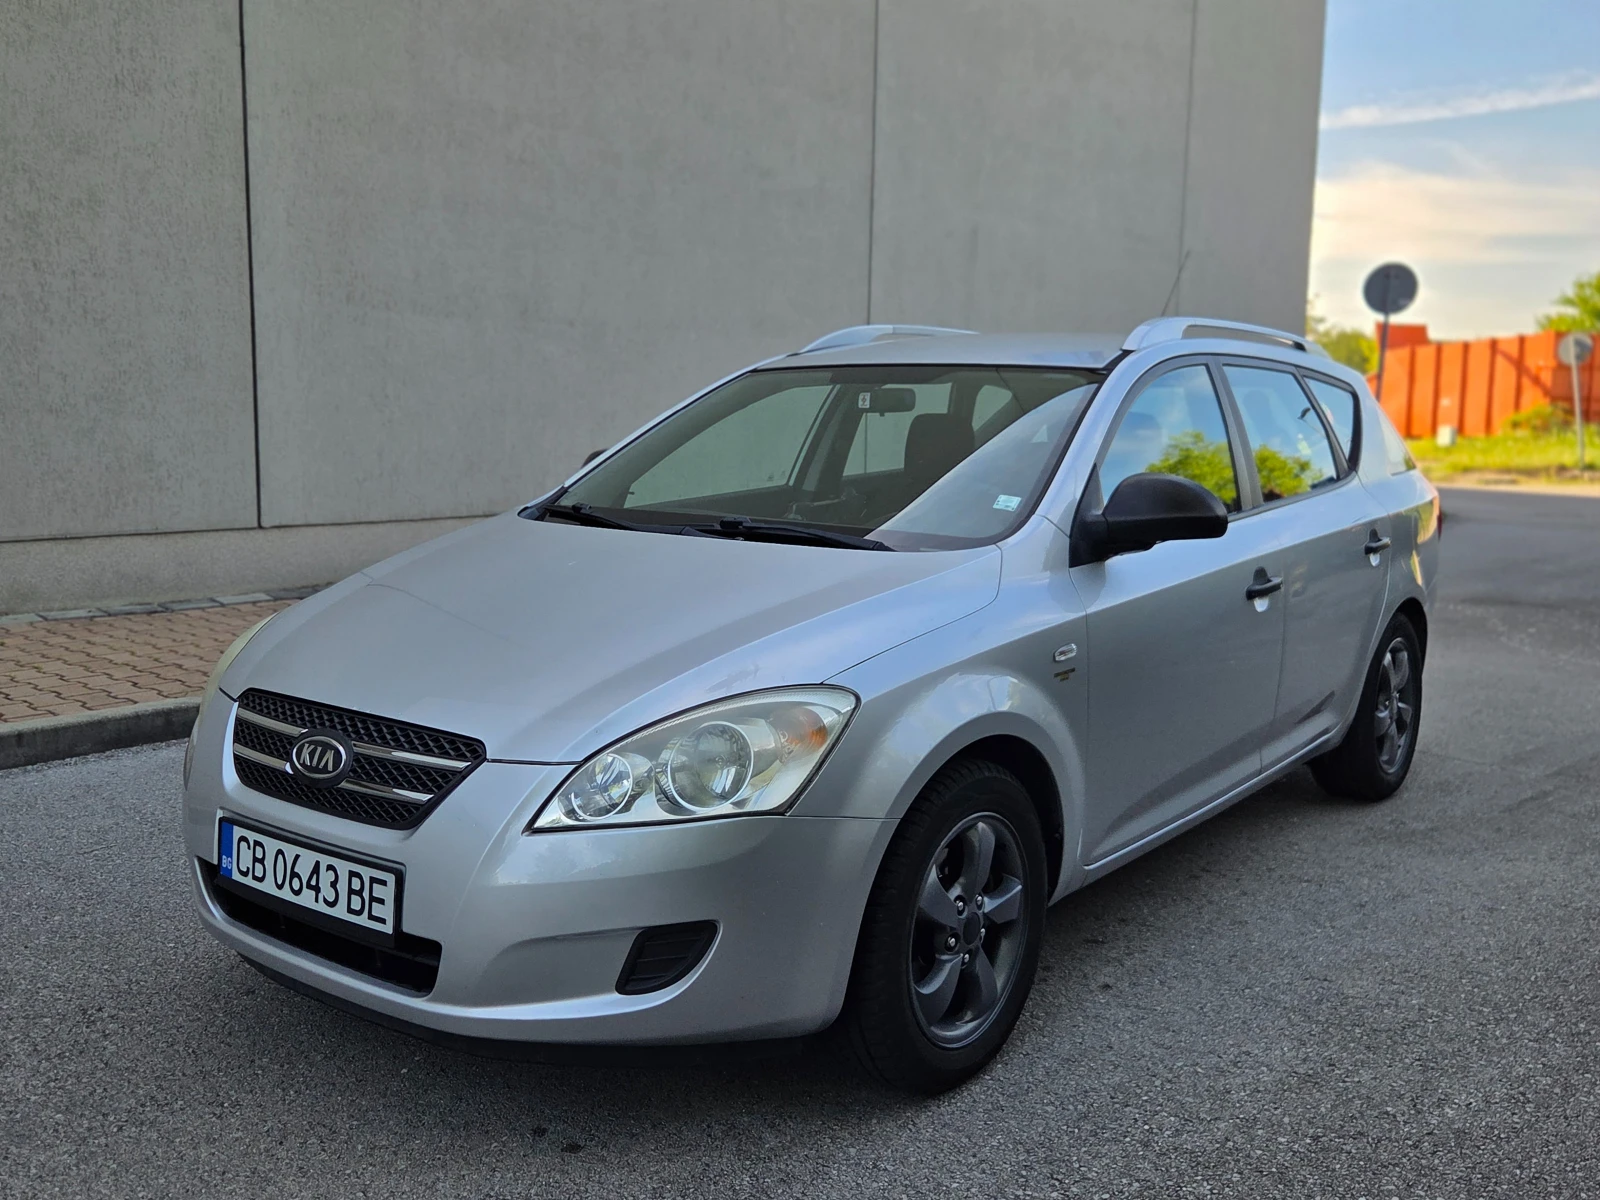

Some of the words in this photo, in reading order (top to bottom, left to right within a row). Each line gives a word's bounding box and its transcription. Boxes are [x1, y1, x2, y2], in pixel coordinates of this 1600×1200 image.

[300, 743, 334, 771] KIA
[222, 855, 232, 870] BG
[236, 835, 266, 883] CB
[273, 848, 339, 908] 0643
[347, 869, 388, 925] BE
